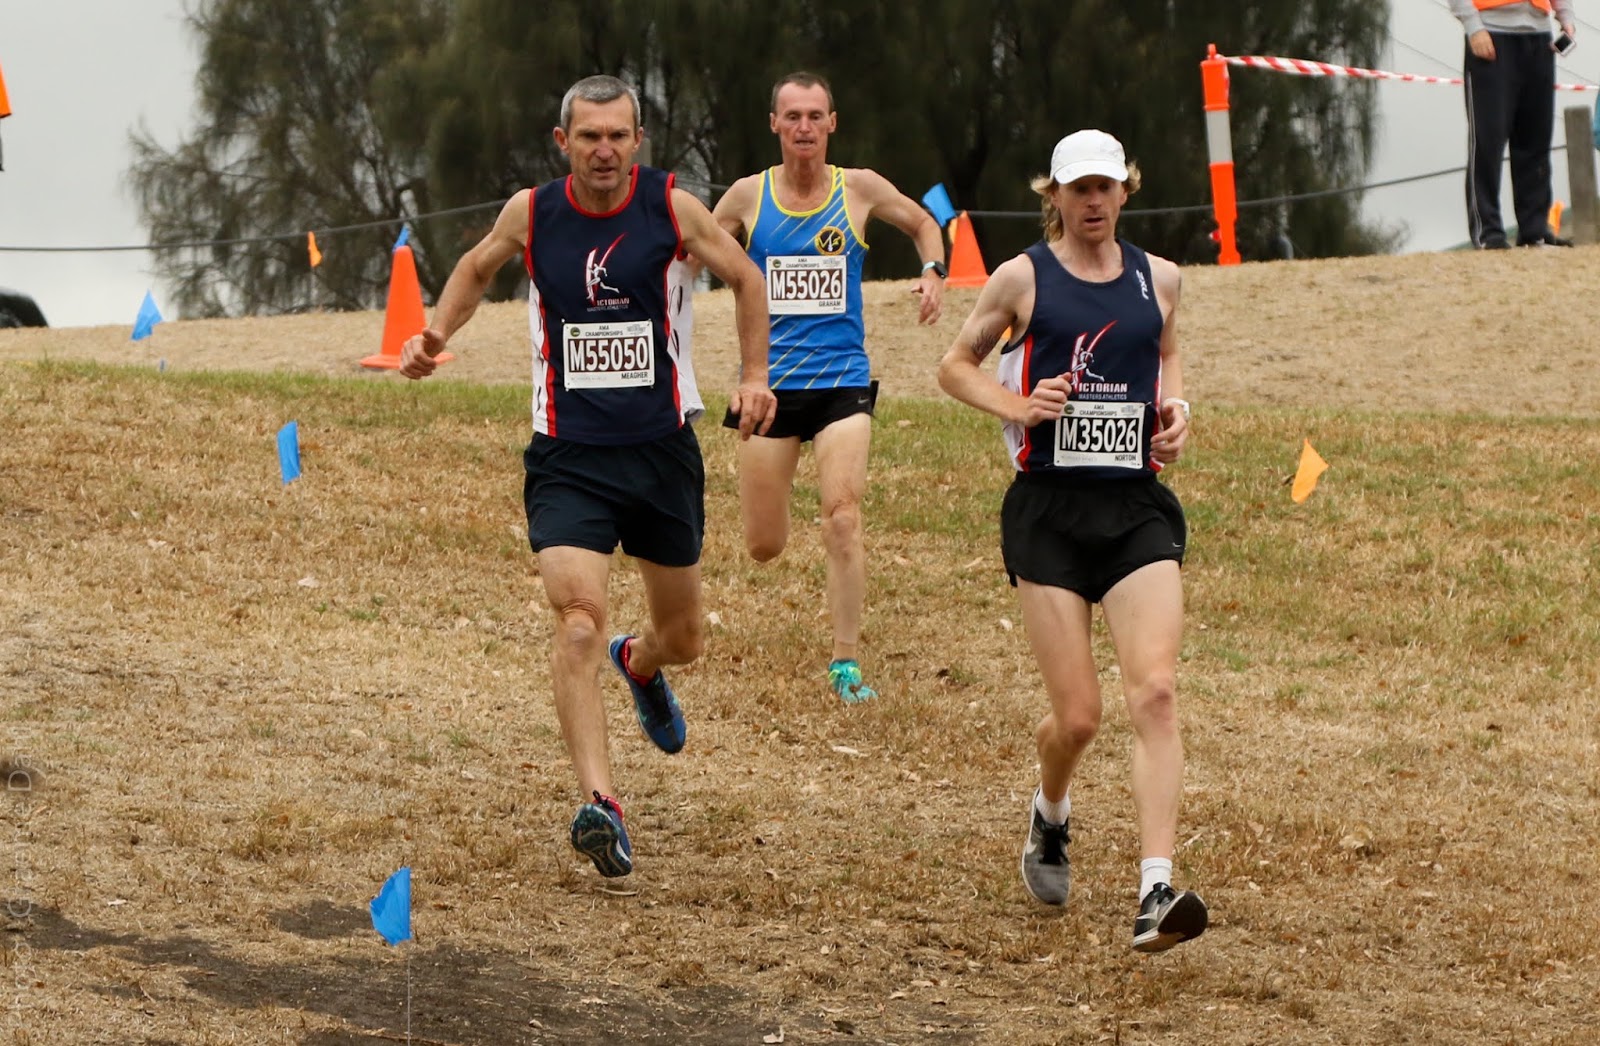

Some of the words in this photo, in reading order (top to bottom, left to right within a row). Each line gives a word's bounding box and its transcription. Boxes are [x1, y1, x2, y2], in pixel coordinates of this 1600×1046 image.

[772, 270, 841, 299] M55026
[569, 337, 648, 371] M55050
[1061, 417, 1137, 452] M35026
